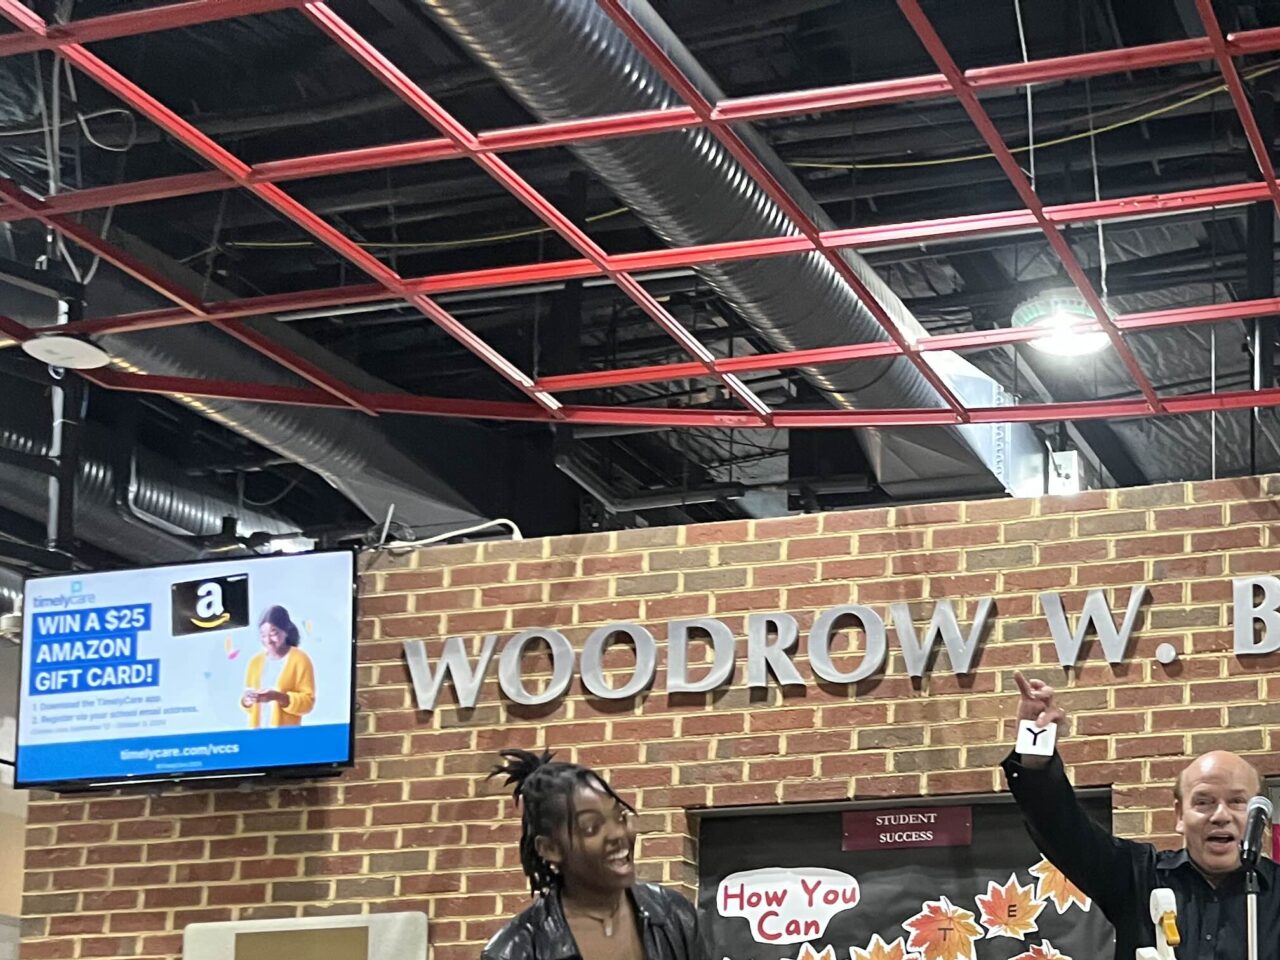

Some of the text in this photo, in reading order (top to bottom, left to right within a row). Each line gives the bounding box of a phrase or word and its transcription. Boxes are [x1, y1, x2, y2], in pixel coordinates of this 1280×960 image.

[33, 593, 95, 608] timelycare
[38, 608, 145, 635] WIN A $25
[37, 637, 131, 663] AMAZON
[403, 597, 995, 711] WOODROW
[1040, 585, 1176, 666] W.
[35, 664, 152, 691] GIFT CARD!
[1026, 727, 1047, 746] Y
[120, 743, 239, 761] timelycare.com/vccs
[876, 813, 937, 826] STUDENT
[879, 830, 933, 844] SUCCESS
[723, 879, 857, 911] How You
[757, 912, 820, 941] Can
